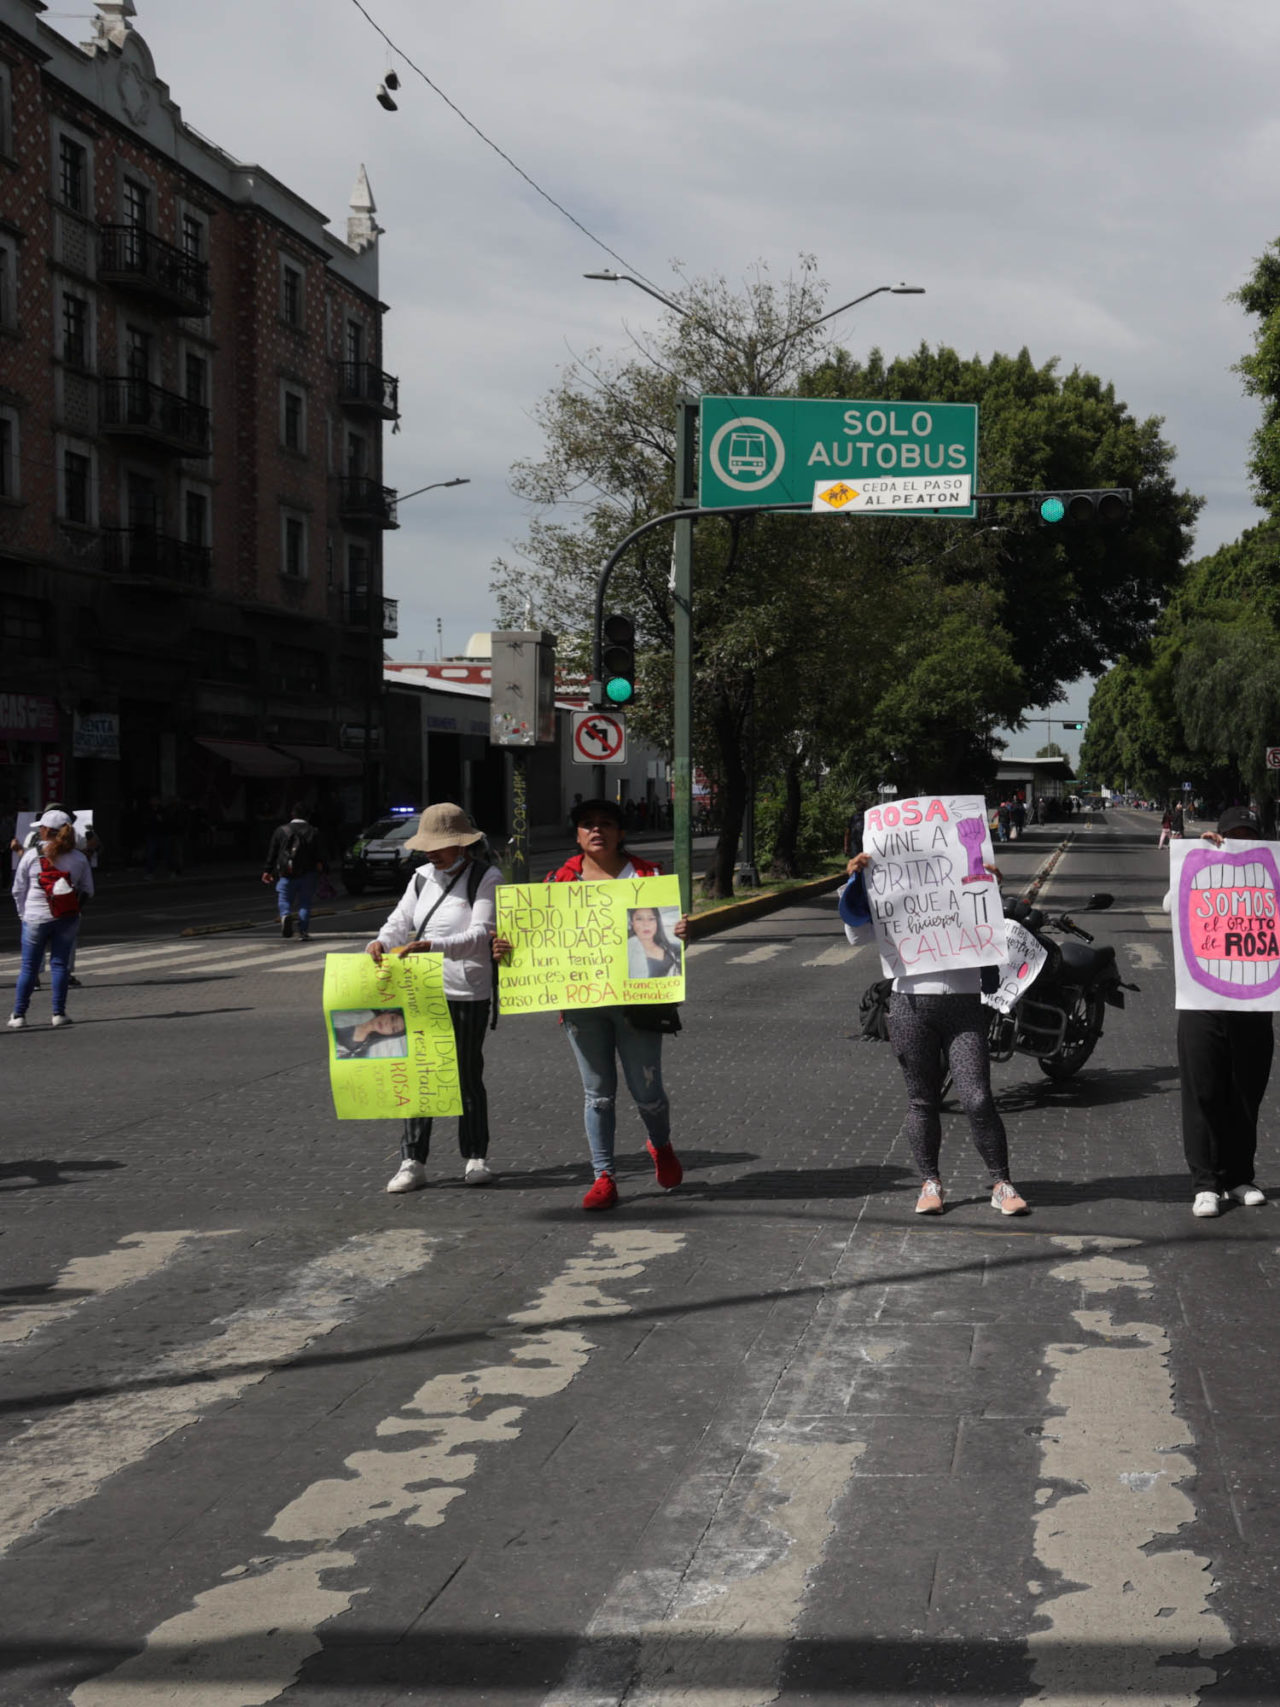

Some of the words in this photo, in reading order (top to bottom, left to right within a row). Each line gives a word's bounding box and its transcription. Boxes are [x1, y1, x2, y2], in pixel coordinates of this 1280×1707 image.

[843, 410, 932, 436] SOLO
[808, 441, 966, 469] AUTOBUS
[862, 482, 896, 493] CEDA
[904, 480, 918, 492] EL
[924, 479, 962, 490] PASO
[864, 496, 886, 506] AL
[892, 492, 960, 504] PEATON
[868, 800, 950, 832] ROSA
[872, 828, 922, 858] VINE
[932, 826, 948, 849] A
[872, 854, 956, 896] GRITAR
[498, 885, 532, 909] EN
[545, 884, 555, 908] 1
[568, 884, 613, 909] MES
[632, 882, 645, 905] Y
[874, 898, 894, 920] LO
[904, 894, 942, 918] QUE
[948, 890, 960, 911] A
[962, 888, 988, 925] TI
[1196, 890, 1276, 918] SOMOS
[498, 908, 564, 930] MEDIO
[576, 908, 615, 930] LAS
[880, 920, 901, 937] TE
[1204, 916, 1222, 932] el
[1227, 916, 1276, 932] GRITO
[500, 926, 622, 948] AUTORIDADES
[898, 924, 1004, 966] CALLAR
[1201, 935, 1221, 950] de
[1225, 931, 1280, 957] ROSA
[530, 949, 560, 966] han
[568, 948, 614, 966] tenido
[500, 970, 566, 989] avances
[570, 970, 588, 980] en
[596, 966, 610, 980] el
[500, 990, 533, 1008] caso
[538, 986, 558, 1004] de
[566, 982, 618, 1004] ROSA
[398, 956, 422, 1018] Exigimos
[413, 1030, 436, 1114] resultados
[422, 957, 460, 1114] AUTORIDADES
[390, 1062, 410, 1106] ROSA
